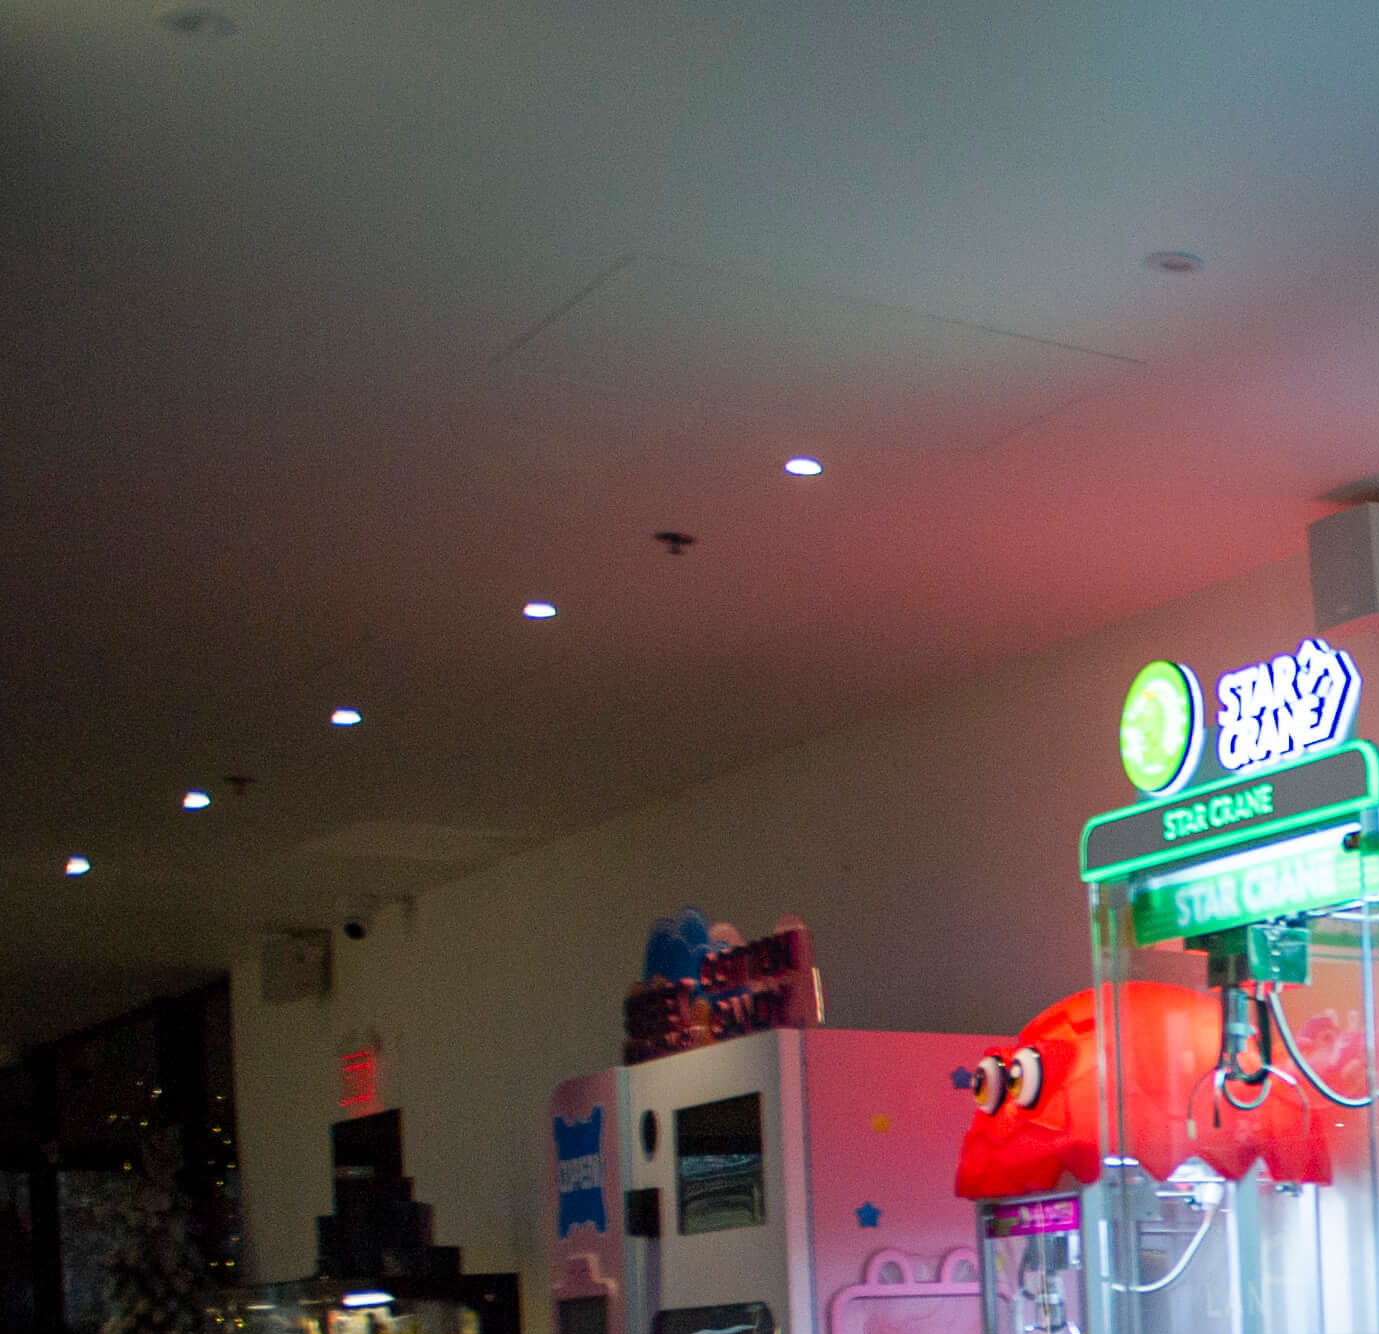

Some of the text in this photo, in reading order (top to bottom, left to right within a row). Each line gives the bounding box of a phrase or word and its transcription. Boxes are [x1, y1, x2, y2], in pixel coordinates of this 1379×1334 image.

[1216, 655, 1302, 729] STAR
[1217, 697, 1326, 770] CRANE
[1163, 783, 1274, 840] STAR CRANE
[1175, 851, 1336, 927] STAR CRANE
